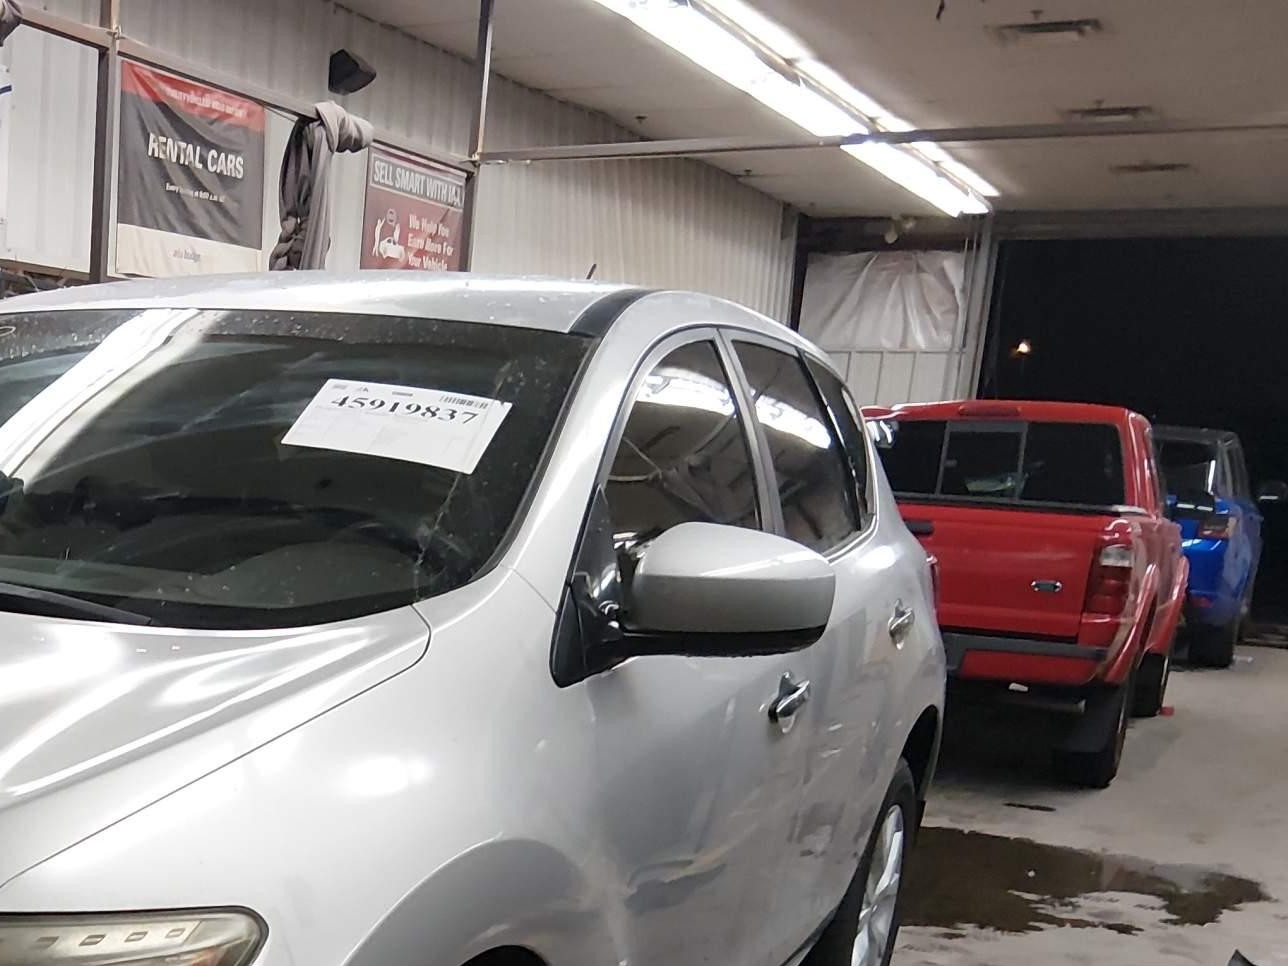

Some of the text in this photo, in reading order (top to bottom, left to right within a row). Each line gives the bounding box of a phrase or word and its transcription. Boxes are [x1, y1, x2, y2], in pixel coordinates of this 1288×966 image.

[147, 132, 244, 179] RENTAL CARS
[373, 160, 394, 186] SELL
[395, 167, 425, 196] SMART
[426, 177, 448, 201] WITH
[409, 213, 450, 238] We Help You
[408, 233, 454, 257] Earn More For
[331, 395, 479, 424] 45919837
